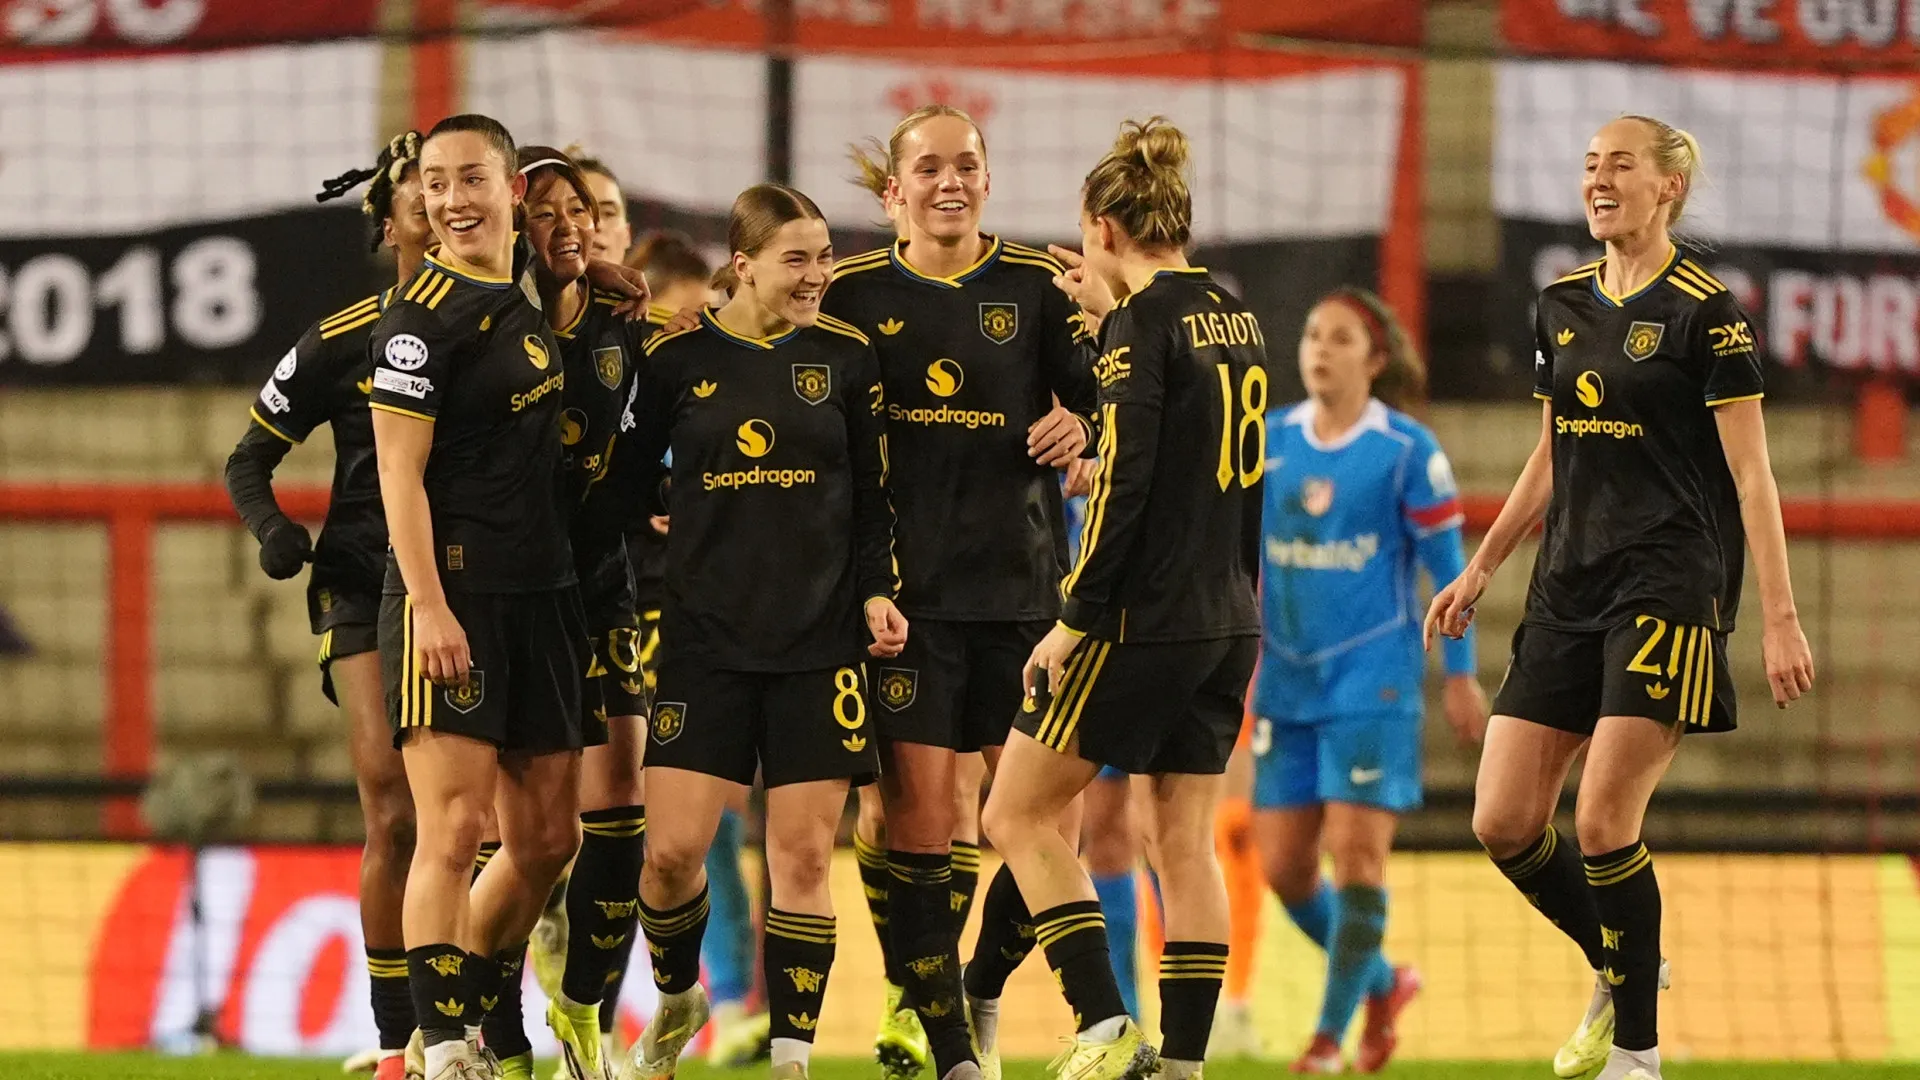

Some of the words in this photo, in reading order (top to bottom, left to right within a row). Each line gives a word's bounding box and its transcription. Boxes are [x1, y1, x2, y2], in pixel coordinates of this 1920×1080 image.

[0, 235, 263, 366] 018
[1182, 312, 1265, 348] ZIGIOT
[1092, 346, 1131, 381] DXC
[511, 371, 564, 412] Snapdrag
[888, 405, 1005, 429] Snapdragon
[1216, 363, 1268, 493] 18
[1555, 416, 1643, 439] Snapdragon
[703, 466, 815, 490] Snapdragon
[1626, 614, 1678, 680] 21
[833, 667, 866, 729] 8
